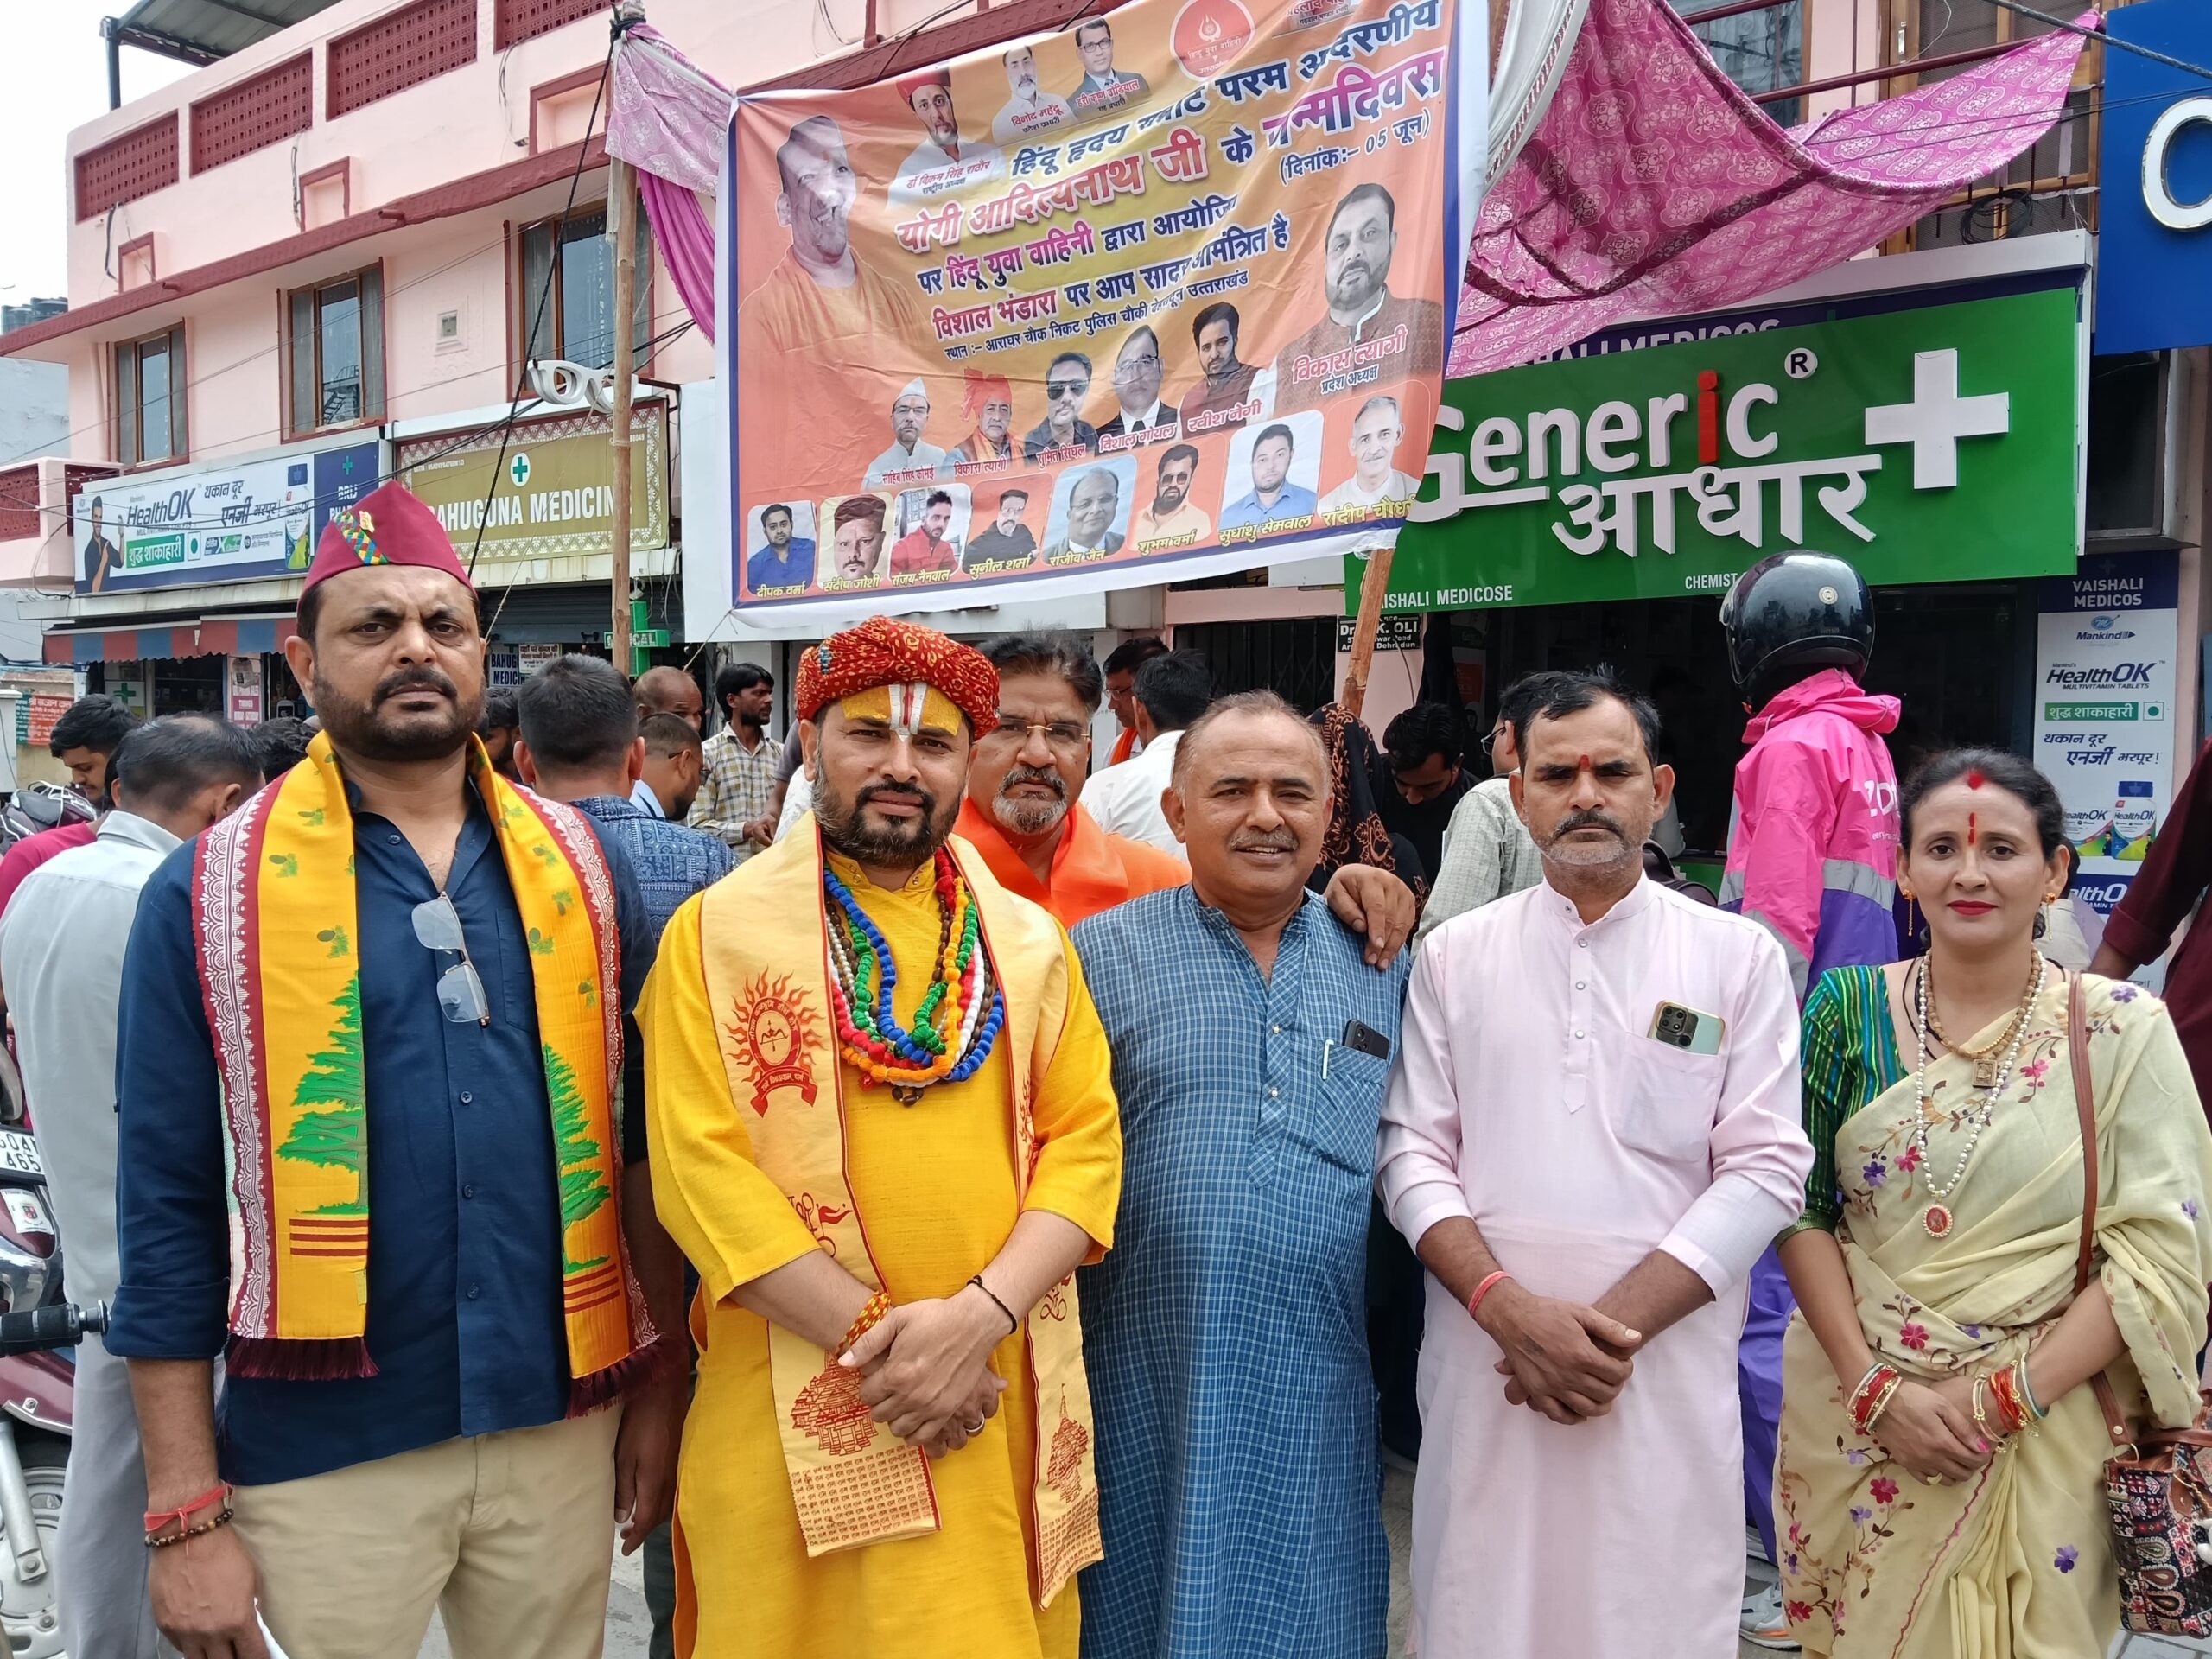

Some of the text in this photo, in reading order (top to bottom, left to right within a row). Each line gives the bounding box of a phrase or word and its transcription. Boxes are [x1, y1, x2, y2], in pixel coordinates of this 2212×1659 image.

[1011, 111, 1037, 126] विनोद
[1012, 145, 1060, 176] हिंदू
[1067, 124, 1128, 164] हृदय
[1215, 61, 1287, 102] परम
[945, 165, 964, 180] सिंह
[897, 204, 963, 251] योगी
[969, 156, 1141, 230] आदित्यनाथ
[1151, 129, 1205, 178] जी
[1220, 127, 1252, 163] के
[918, 269, 943, 295] पर
[946, 253, 987, 290] हिंदू
[987, 245, 1024, 288] युवा
[1026, 219, 1094, 267] वाहिनी
[1101, 221, 1145, 251] द्वारा
[933, 308, 993, 340] विशाल
[996, 293, 1057, 323] भंडारा
[1065, 283, 1091, 307] पर
[1096, 270, 1135, 301] आप
[1271, 213, 1288, 248] है
[985, 334, 1021, 352] आराघर
[1023, 326, 1046, 343] चौक
[1049, 321, 1081, 338] निकट
[1084, 311, 1117, 335] पुलिस
[1120, 301, 1148, 322] चौकी
[1186, 270, 1249, 297] उत्तराखंड
[1292, 323, 1408, 384] विकास त्यागी
[1320, 364, 1379, 394] प्रदेश अध्यक्ष
[1229, 398, 1262, 422] नेगी
[1099, 422, 1177, 454] विशाल गोयल
[954, 458, 1007, 476] विकास त्यागी
[204, 480, 245, 499] थकान दूर
[126, 488, 197, 527] HealthOK
[429, 495, 524, 533] AHUGUNA
[1322, 502, 1367, 526] संदीप
[1551, 454, 1884, 558] आधार
[1218, 514, 1313, 546] सुधांशु सेमवाल
[144, 539, 181, 562] शाकाहारी
[1138, 530, 1197, 556] शुभम वर्मा
[969, 556, 1032, 582] सुनील शर्मा
[1048, 548, 1106, 567] राजीव जैन
[757, 582, 805, 599] दीपक वर्मा
[823, 574, 881, 593] संदीप जोशी
[1685, 573, 1738, 590] CHEMIST
[2073, 577, 2144, 593] VAISHALI
[1435, 584, 1514, 607] MEDICOSE
[2073, 593, 2143, 607] MEDICOS
[1394, 621, 1417, 633] OLI
[2075, 631, 2122, 641] Mankind
[2045, 663, 2157, 683] HealthOK
[2049, 703, 2133, 721] शुद्ध शाकाहारी
[2044, 734, 2108, 747] थकान दूर
[2066, 746, 2117, 766] एनर्जी
[2065, 810, 2108, 820] ealthOK
